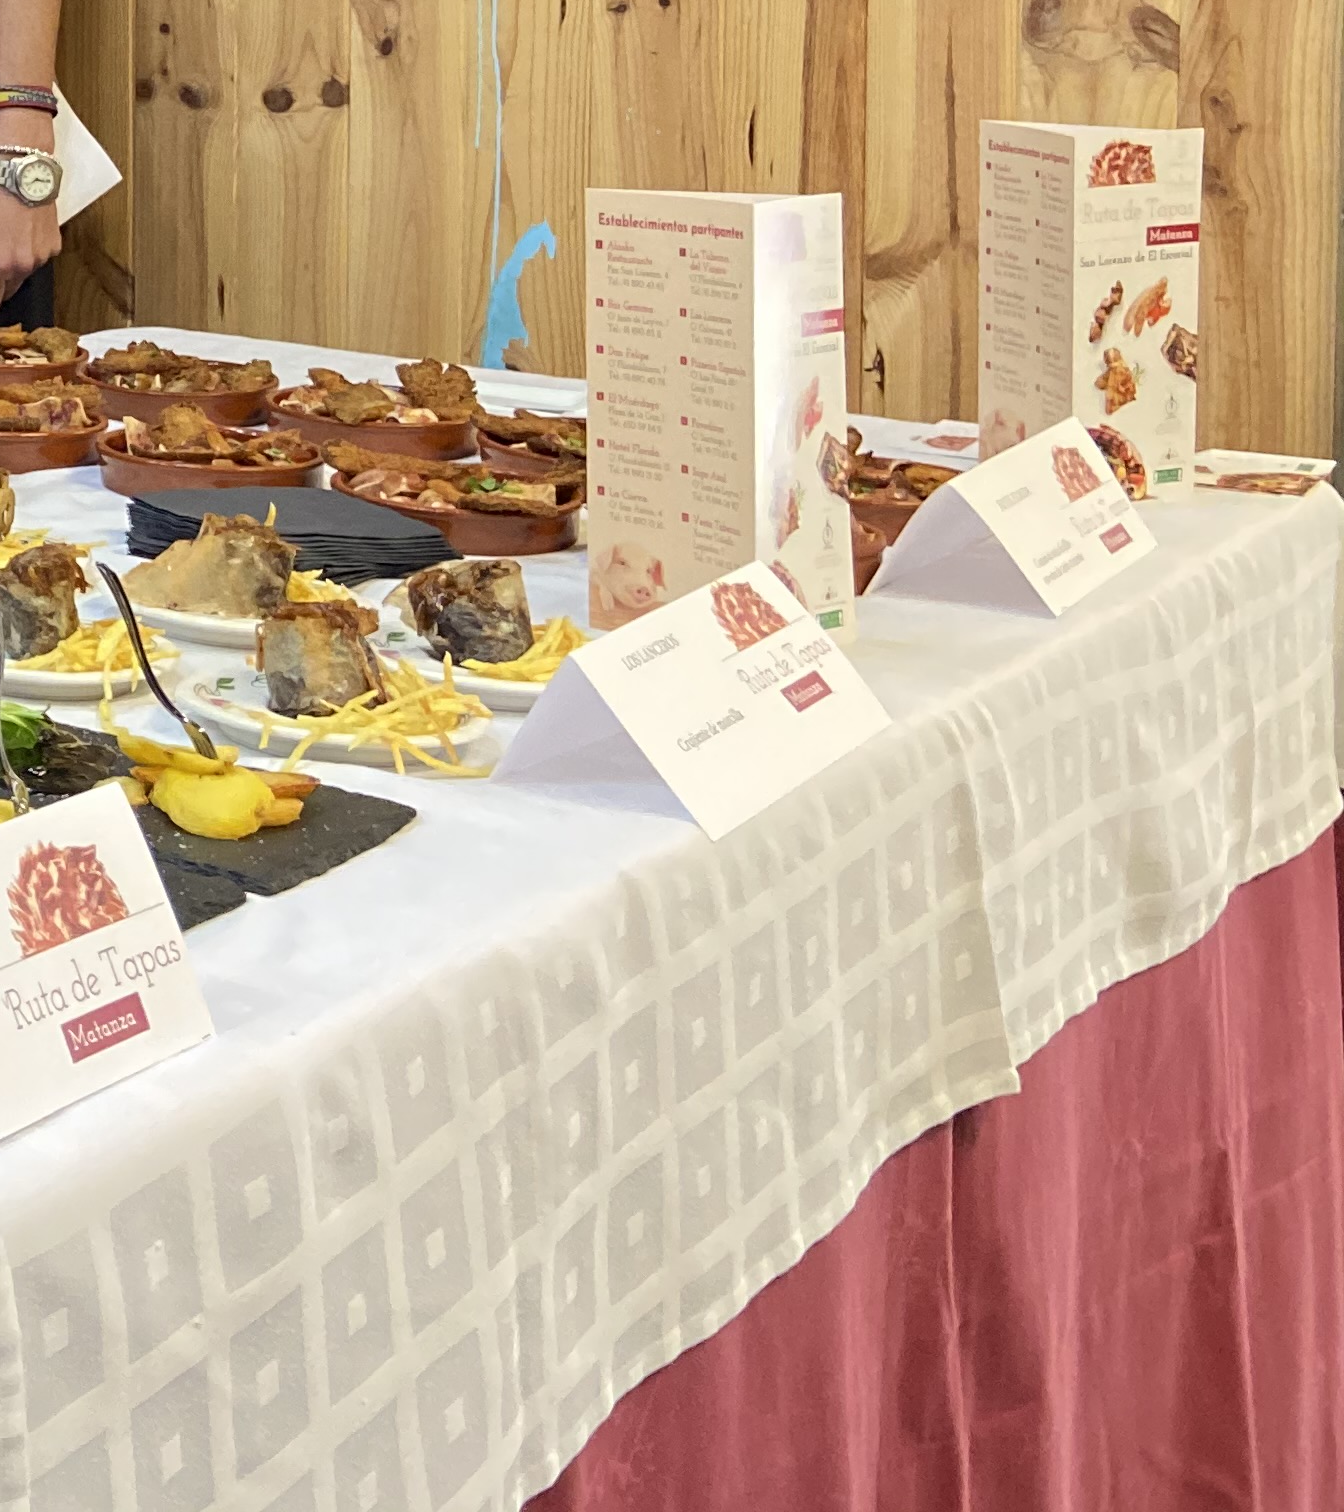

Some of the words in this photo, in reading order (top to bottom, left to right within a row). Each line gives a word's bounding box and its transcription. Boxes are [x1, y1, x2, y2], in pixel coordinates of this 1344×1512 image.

[598, 212, 688, 233] Establecimientos
[1098, 254, 1132, 266] Lorenzo
[1135, 250, 1145, 262] de
[736, 665, 779, 694] Ruta
[767, 650, 794, 677] de
[781, 638, 832, 668] Tapas
[1, 981, 69, 1030] Ruta
[71, 958, 102, 1002] de
[97, 940, 181, 988] Tapas
[67, 1011, 137, 1050] Matanza
